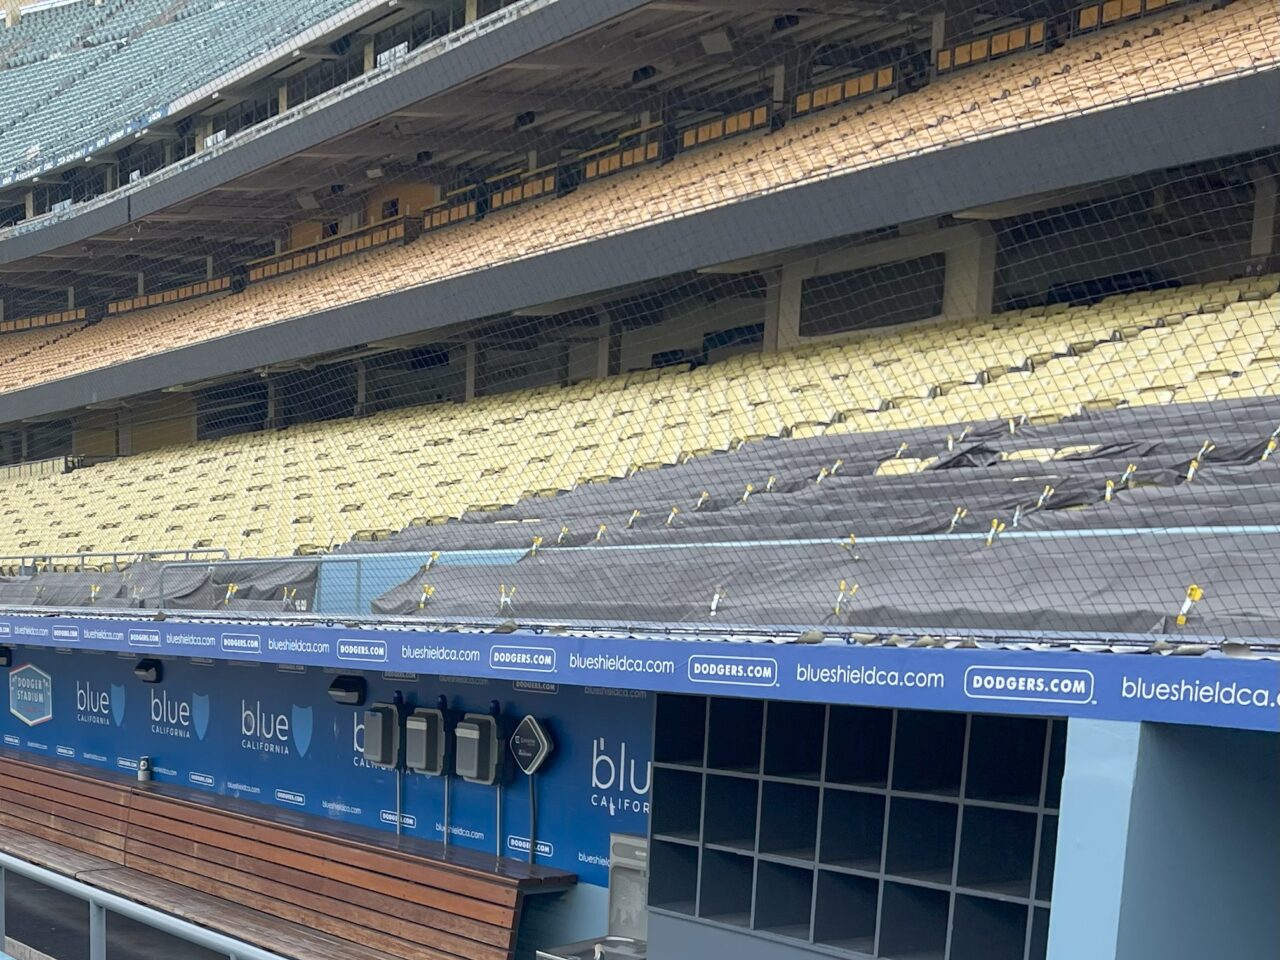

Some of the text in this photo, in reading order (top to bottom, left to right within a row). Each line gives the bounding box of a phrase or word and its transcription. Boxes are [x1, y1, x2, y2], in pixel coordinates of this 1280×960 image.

[166, 634, 216, 646] blueshieldca.com
[223, 638, 259, 648] DODGERS.COM
[268, 638, 330, 653] blueshieldca.com
[340, 645, 385, 656] DODGERS.COM
[401, 645, 481, 662] blueshieldca.com
[493, 652, 552, 666] DODGERS.COM
[569, 652, 675, 674] blueshieldca.com
[694, 663, 772, 678] DODGERS.COM
[796, 663, 945, 689] blueshieldca.com
[972, 675, 1086, 694] DODGERS.COM
[1121, 676, 1280, 708] blueshieldca.
[17, 677, 43, 690] DODGER
[17, 689, 44, 703] STADIUM
[76, 681, 110, 714] blue
[151, 688, 190, 727] blue
[77, 713, 110, 726] CALIFORNIA
[241, 699, 289, 741] blue
[151, 724, 191, 739] CALIFORNIA
[241, 738, 289, 755] CALIFORNIA
[591, 739, 652, 795] blu
[590, 793, 651, 815] CALIFOR
